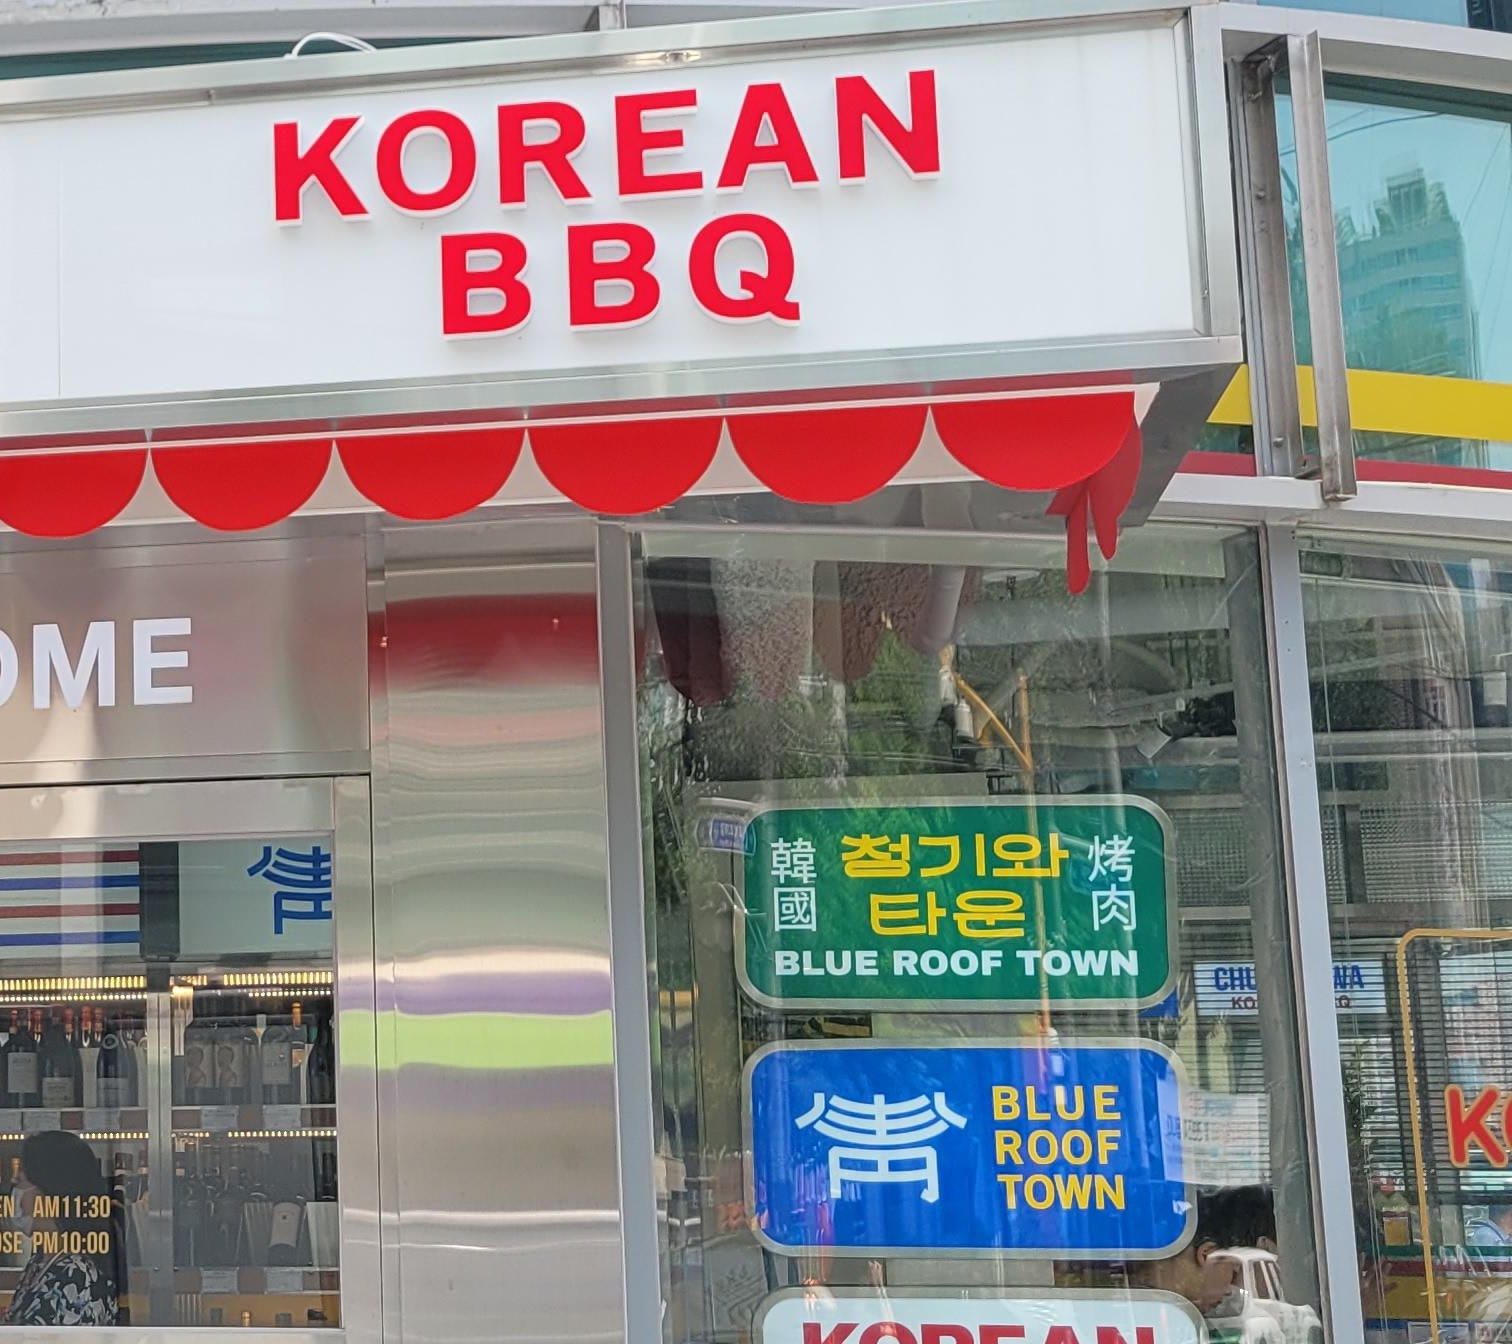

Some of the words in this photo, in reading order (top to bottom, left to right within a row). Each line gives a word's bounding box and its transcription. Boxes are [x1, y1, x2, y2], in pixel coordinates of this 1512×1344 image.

[272, 69, 941, 222] KOREAN
[440, 213, 801, 335] BBQ
[841, 832, 1069, 879] 청기와
[771, 837, 817, 932] 韓國
[1087, 835, 1137, 933] 烤肉
[869, 891, 1026, 938] 타운
[775, 950, 879, 976] BLUE
[893, 950, 1003, 976] ROOF
[1016, 950, 1139, 976] TOWN
[992, 1084, 1121, 1121] BLUE
[995, 1129, 1121, 1166] ROOF
[1445, 1084, 1512, 1169] K
[997, 1174, 1126, 1211] TOWN
